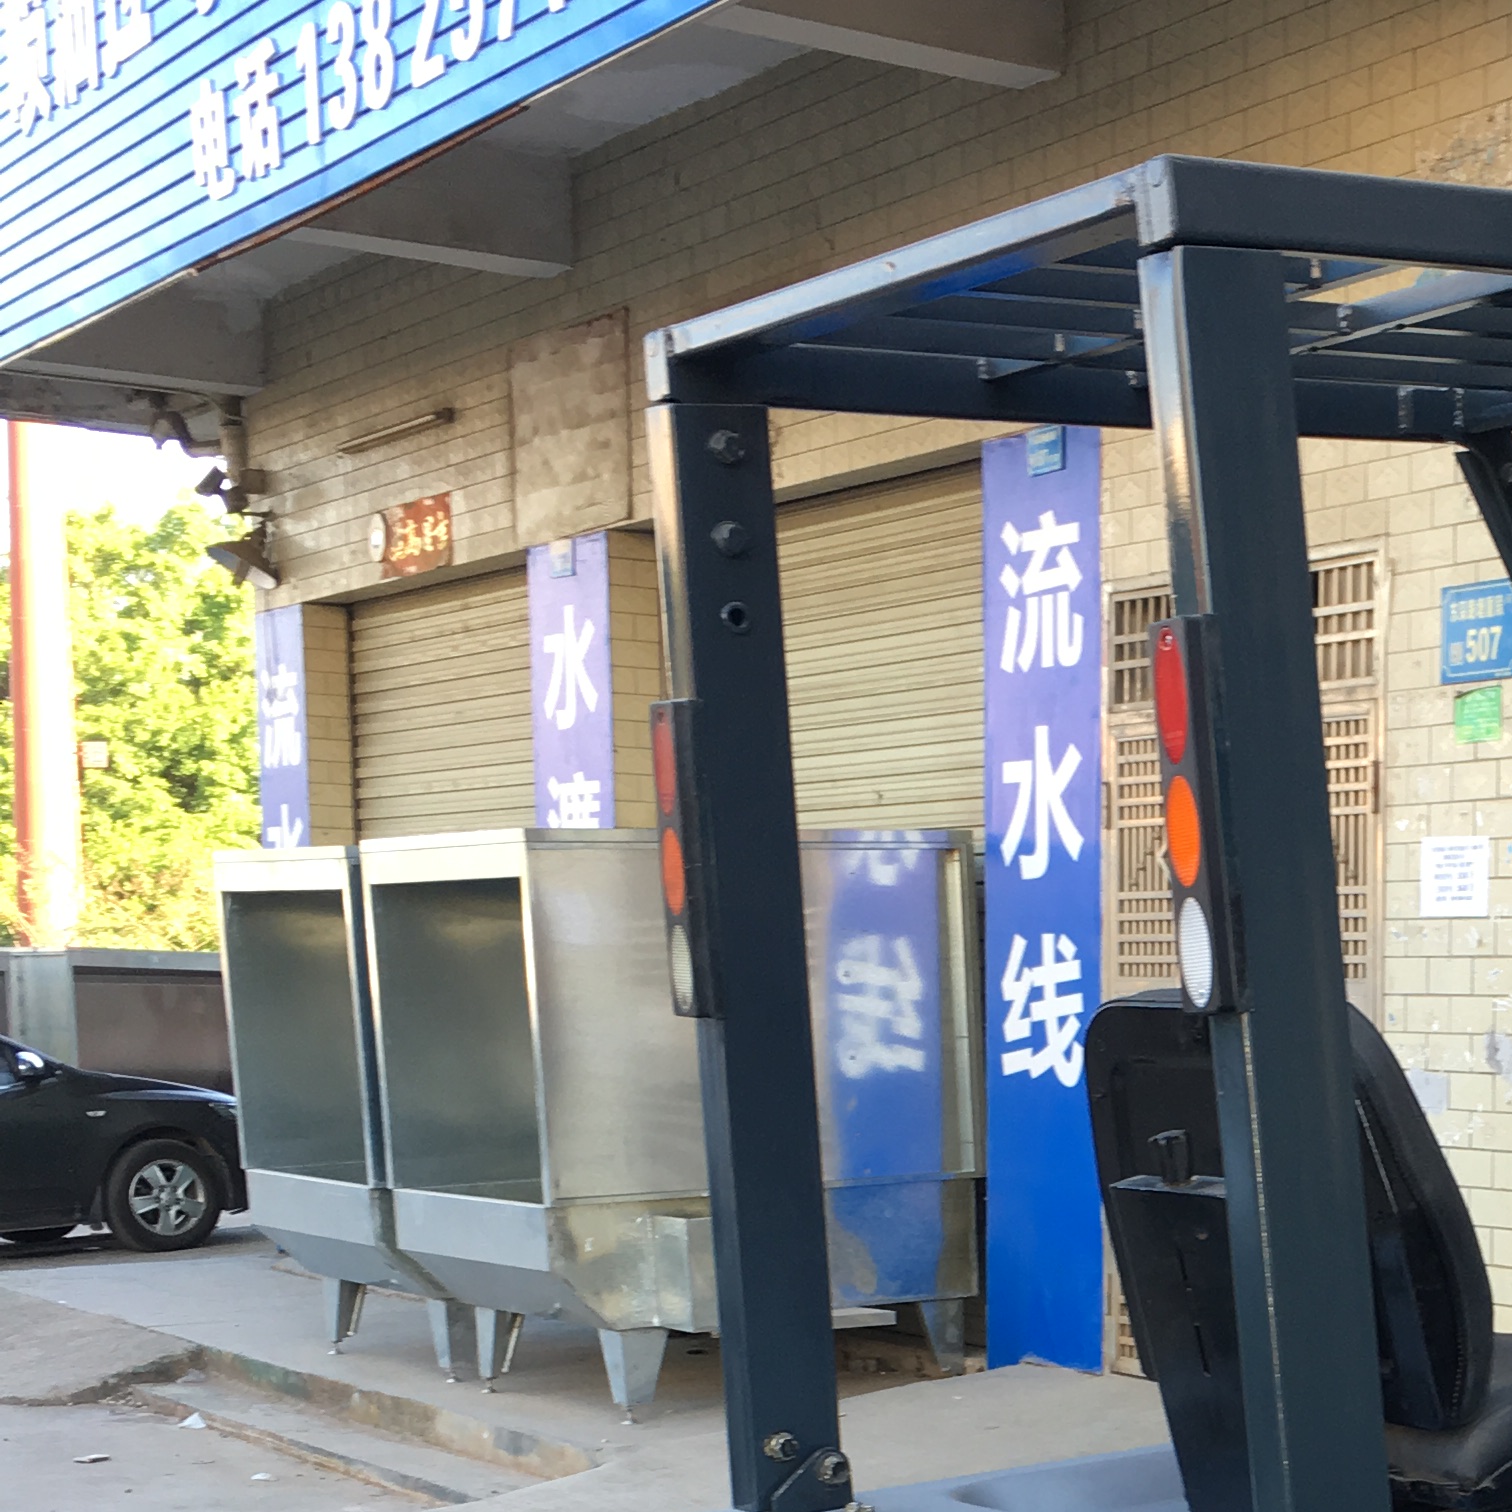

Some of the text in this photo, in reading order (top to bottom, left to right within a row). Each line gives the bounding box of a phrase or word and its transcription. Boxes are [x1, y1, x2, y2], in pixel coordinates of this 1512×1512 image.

[190, 37, 279, 200] 电话
[1465, 625, 1503, 663] 507
[1000, 509, 1085, 1088] 流水线
